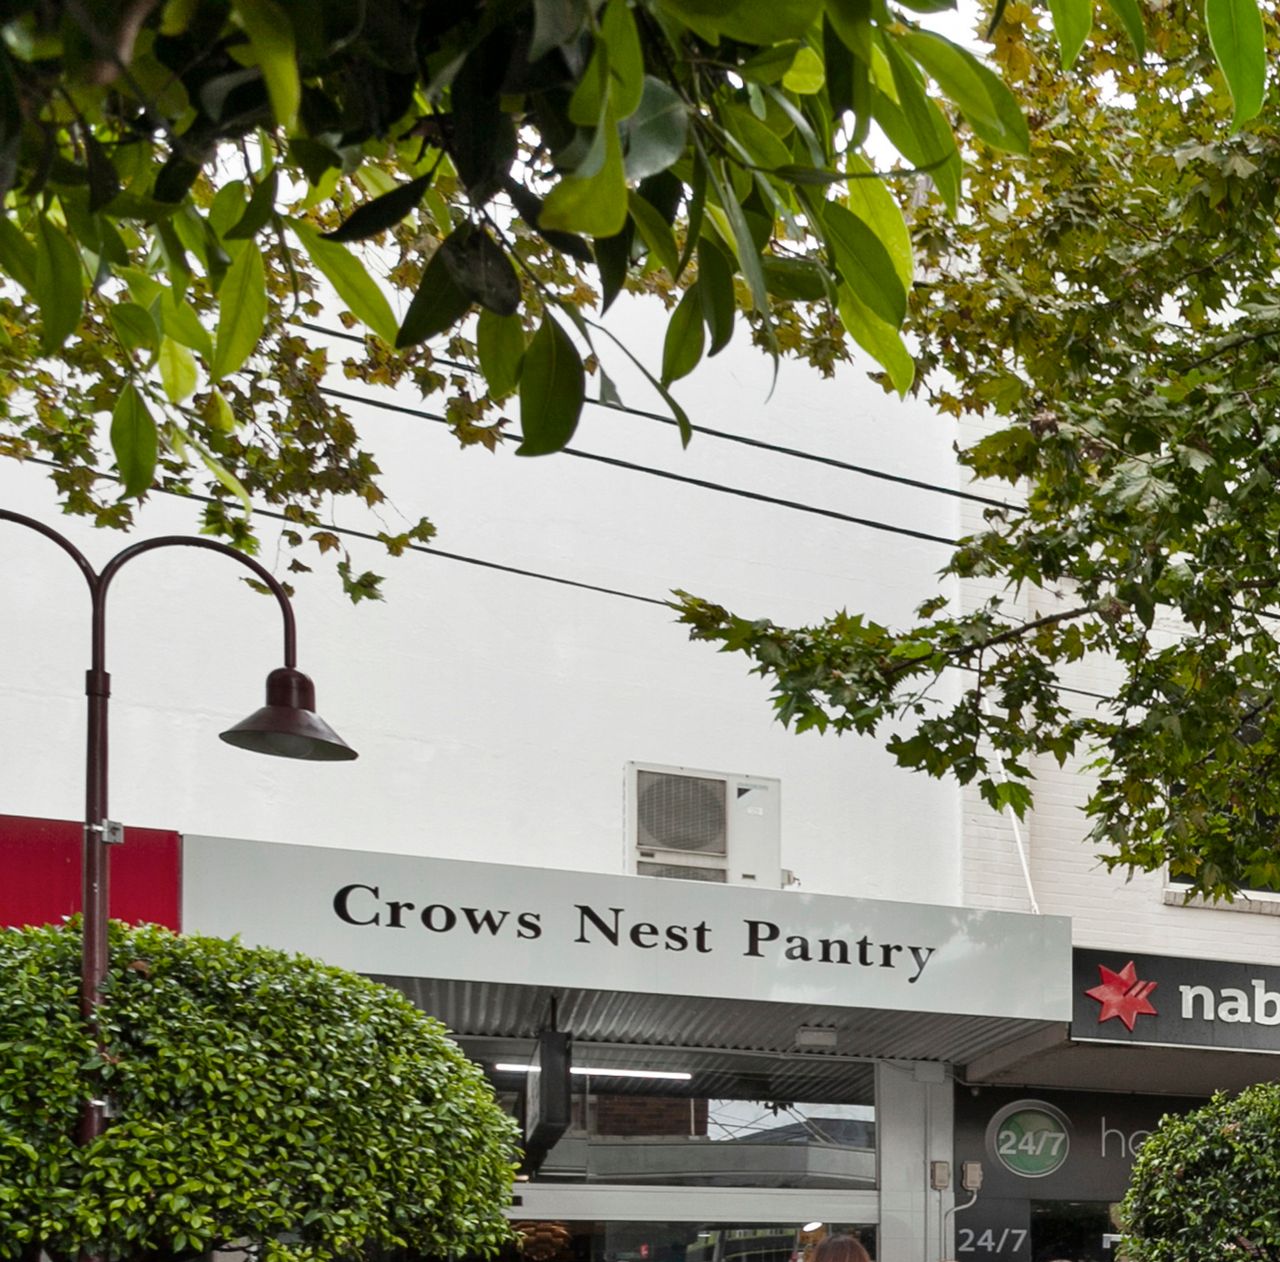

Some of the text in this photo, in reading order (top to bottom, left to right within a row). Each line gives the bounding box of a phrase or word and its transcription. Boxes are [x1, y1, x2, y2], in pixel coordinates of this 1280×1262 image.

[332, 883, 937, 984] Crows Nest Pantry
[998, 1131, 1066, 1156] 24/7
[957, 1228, 1028, 1253] 24/7
